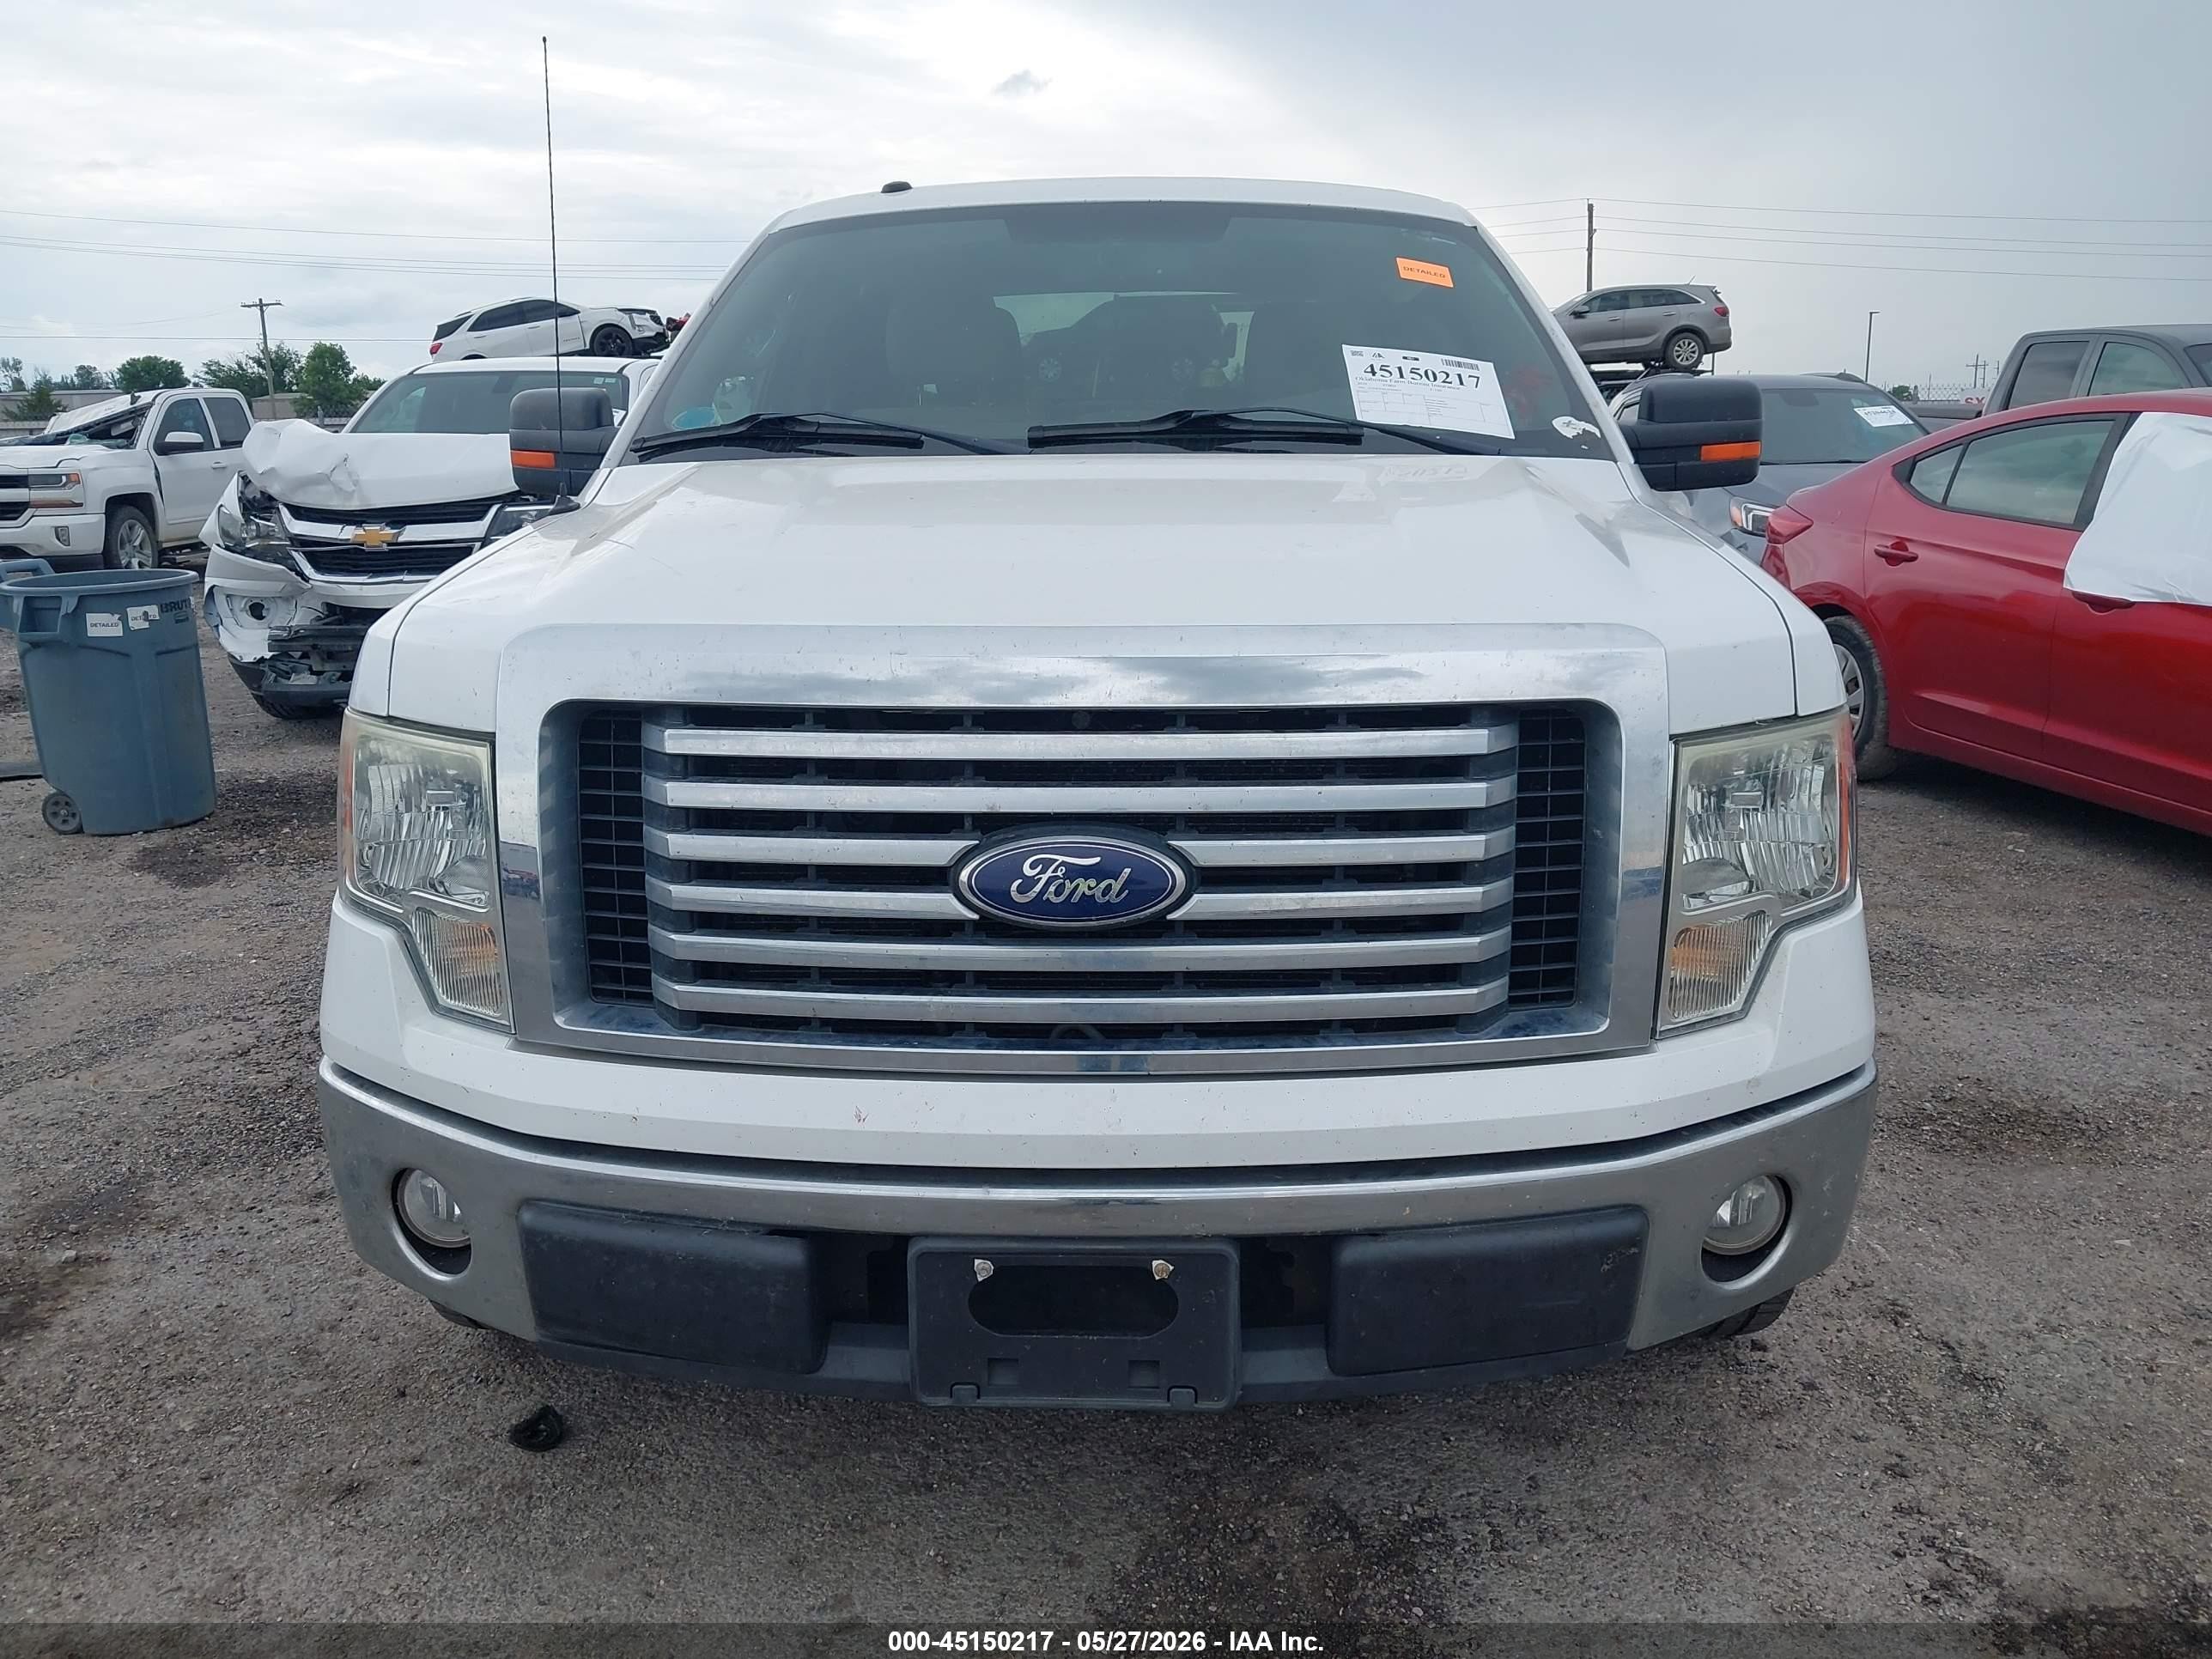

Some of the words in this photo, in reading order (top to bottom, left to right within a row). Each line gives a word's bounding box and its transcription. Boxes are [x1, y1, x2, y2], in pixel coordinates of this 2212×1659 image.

[1403, 266, 1445, 278] DETAILED
[1364, 363, 1480, 389] 45150217
[1010, 854, 1132, 902] Ford
